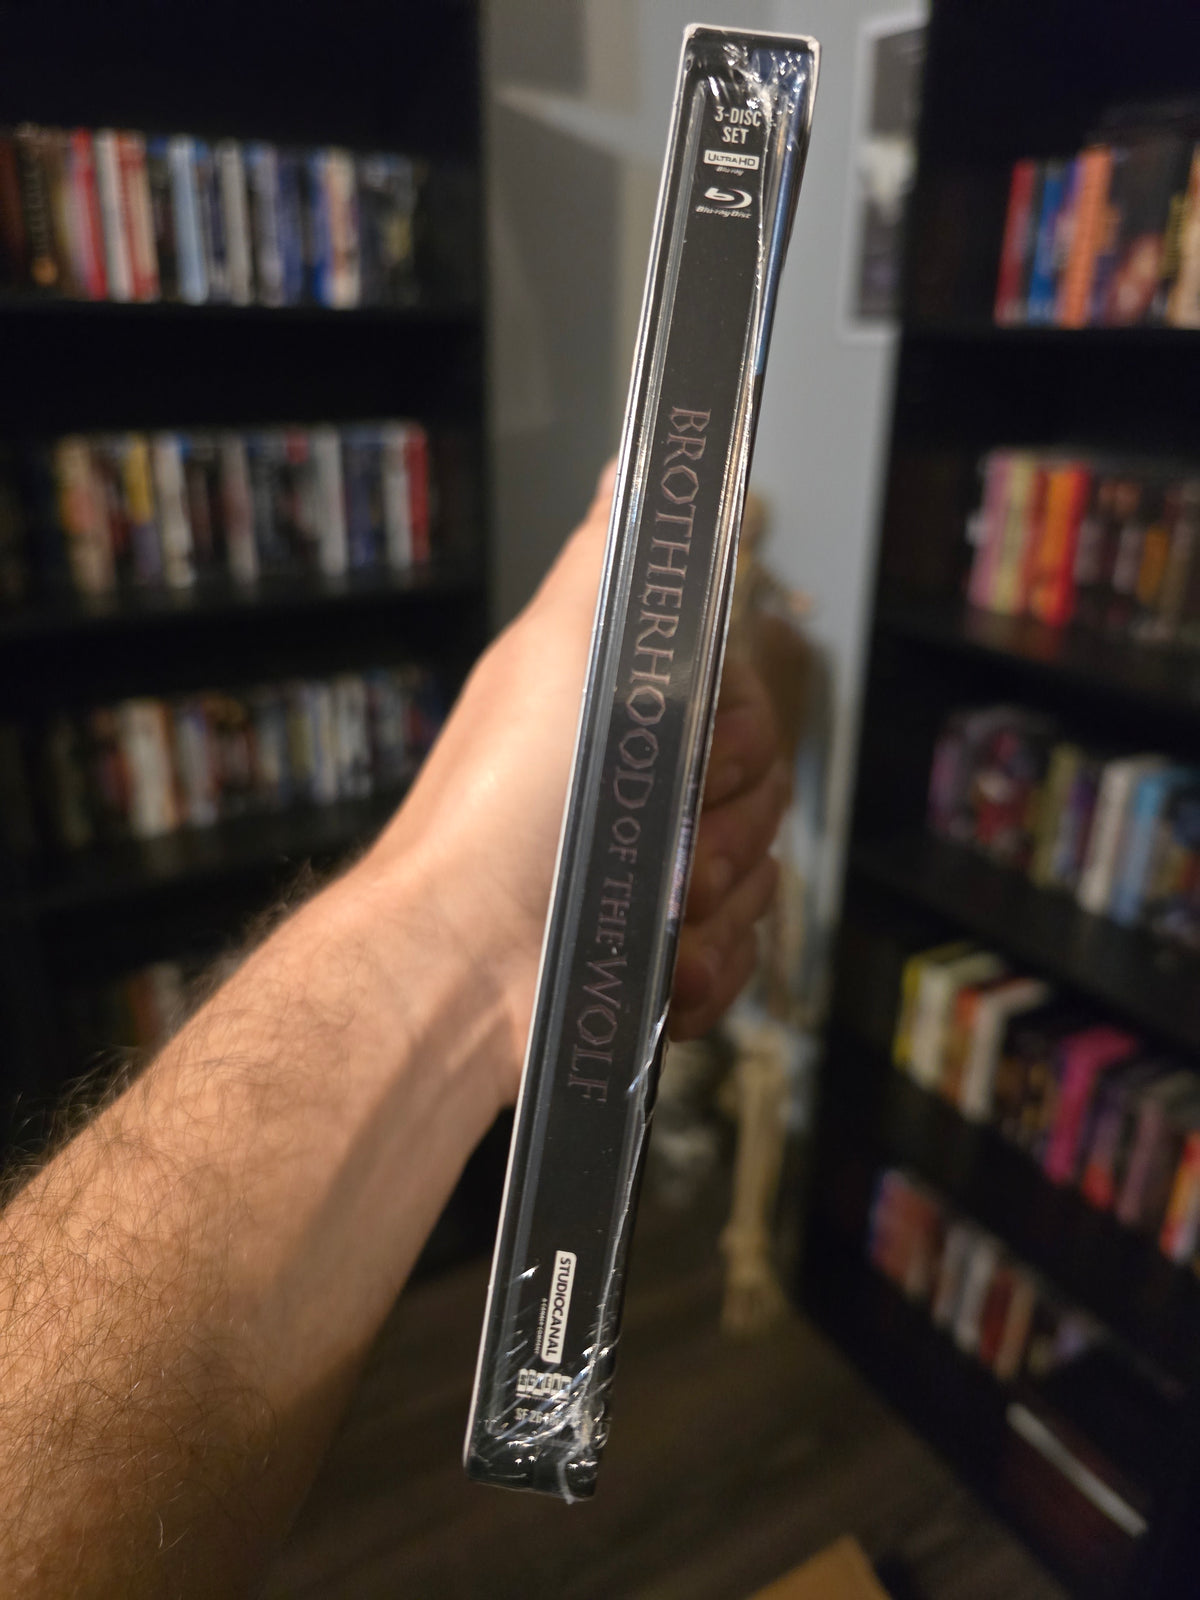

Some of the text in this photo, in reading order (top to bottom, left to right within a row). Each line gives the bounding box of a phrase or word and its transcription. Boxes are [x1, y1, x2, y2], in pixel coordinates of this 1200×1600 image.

[714, 105, 762, 127] 3-DISC
[722, 126, 749, 145] SET
[567, 405, 712, 1104] BROTHERHOOD OF THE WOLF
[545, 1256, 572, 1357] STUDIOCANAL
